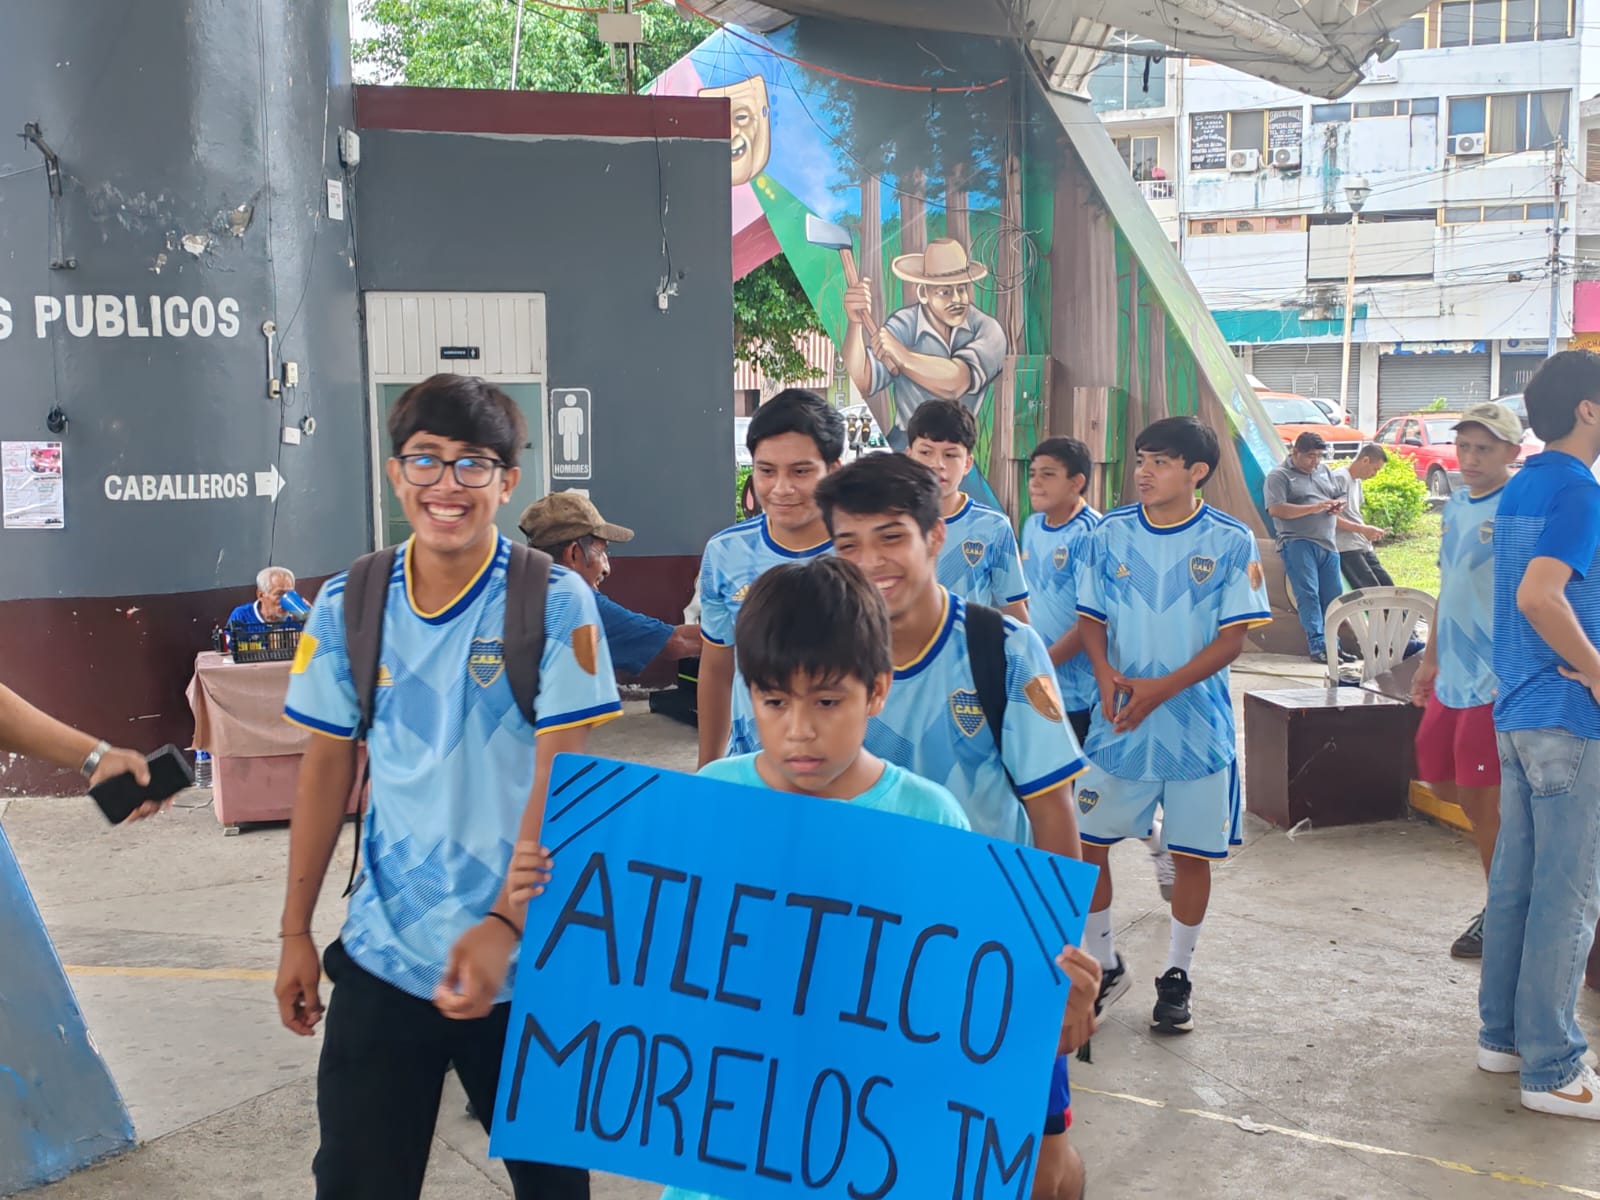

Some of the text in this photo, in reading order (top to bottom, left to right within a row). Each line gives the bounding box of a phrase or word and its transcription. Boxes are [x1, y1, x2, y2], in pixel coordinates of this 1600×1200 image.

[34, 294, 240, 339] PUBLICOS
[554, 463, 589, 474] HOMBRES
[104, 473, 249, 501] CABALLEROS
[954, 703, 983, 715] CAB
[534, 851, 1015, 1066] ATLETICO
[505, 1012, 1035, 1200] MORELOS TM
